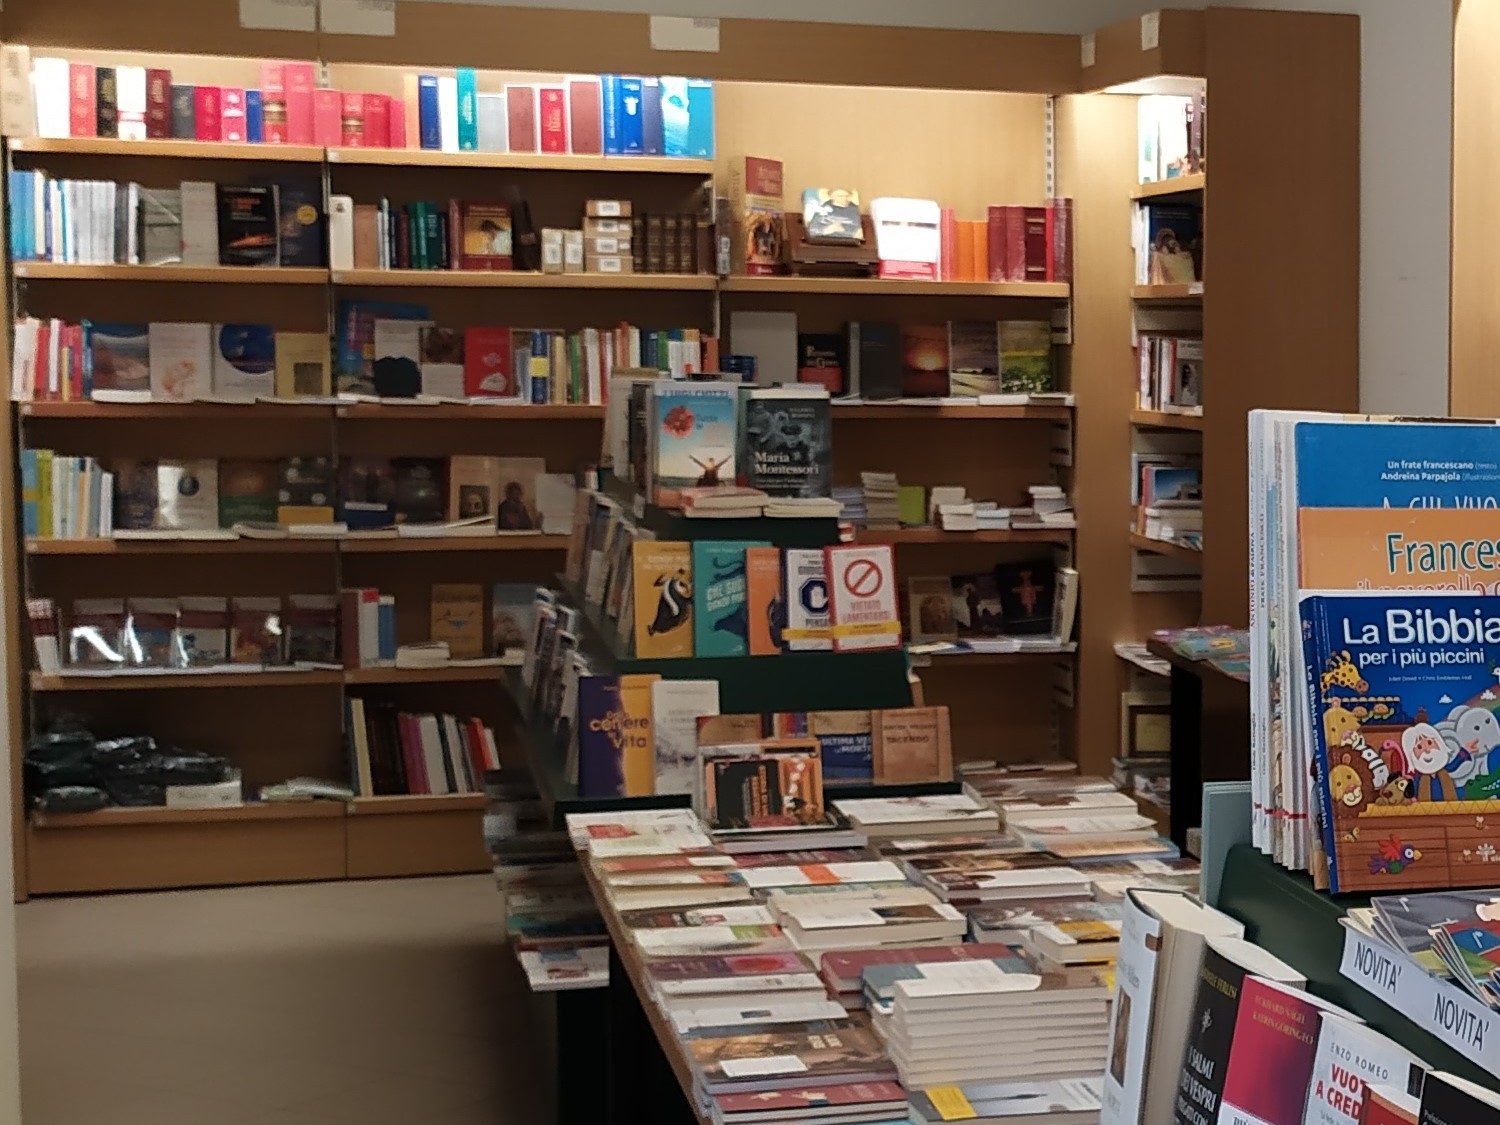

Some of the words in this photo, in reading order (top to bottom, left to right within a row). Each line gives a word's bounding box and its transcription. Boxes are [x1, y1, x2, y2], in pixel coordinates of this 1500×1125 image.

[754, 451, 790, 463] Maria
[1388, 460, 1399, 469] Un
[1401, 460, 1420, 470] frate
[1421, 460, 1474, 470] francescano
[755, 463, 819, 475] Montessori
[1381, 472, 1420, 481] Andreina
[1421, 472, 1461, 483] Parpajola
[1343, 617, 1379, 645] La
[1359, 651, 1387, 669] per
[1400, 649, 1426, 669] più
[1430, 648, 1484, 667] piccini
[1354, 942, 1402, 994] NOVITA'
[1434, 993, 1490, 1051] NOVITA'
[1331, 1042, 1350, 1061] ENZO
[1355, 1058, 1389, 1080] ROMEO
[1315, 1080, 1324, 1100] A
